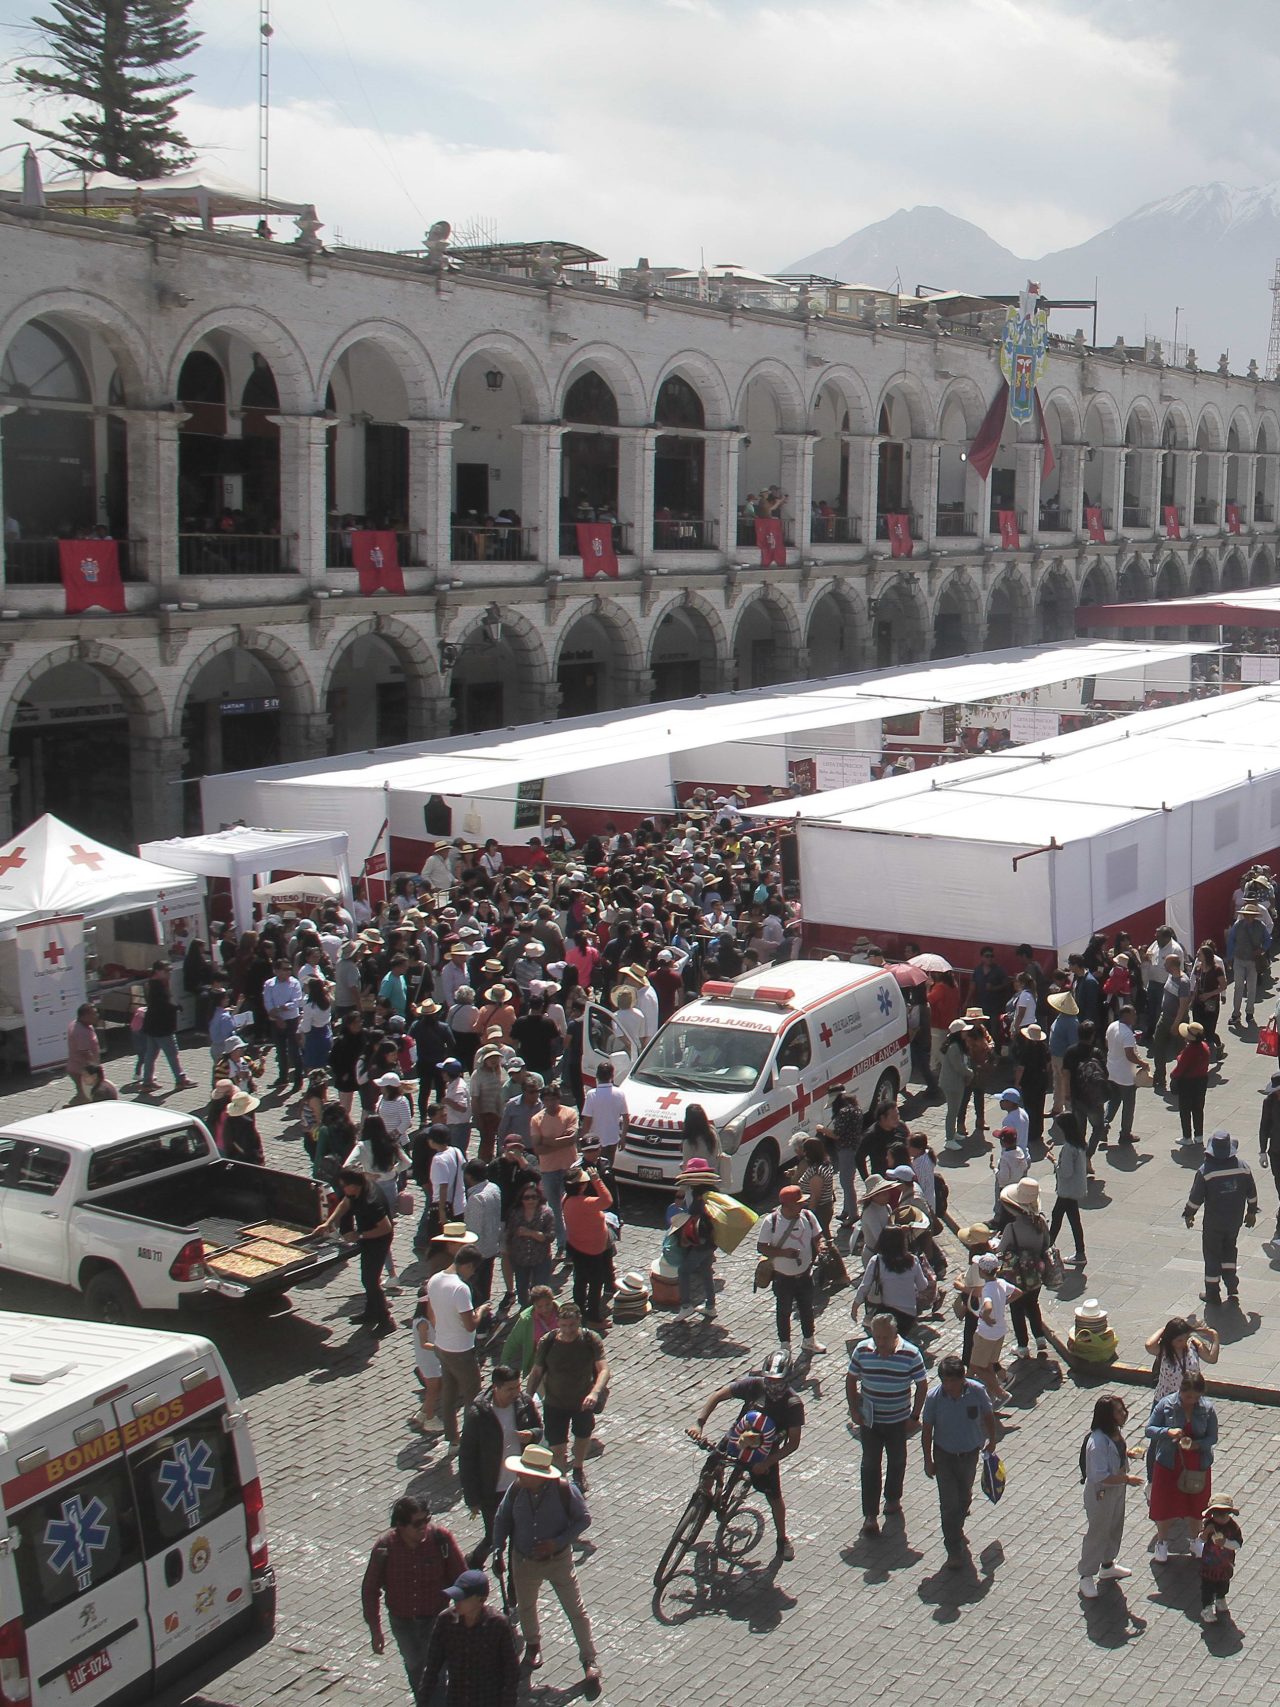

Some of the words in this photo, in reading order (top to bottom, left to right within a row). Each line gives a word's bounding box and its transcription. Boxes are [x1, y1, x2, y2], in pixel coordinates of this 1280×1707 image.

[271, 895, 299, 903] QUESO
[851, 1041, 900, 1078] AMBULANCIA
[46, 1398, 185, 1482] BOMBEROS
